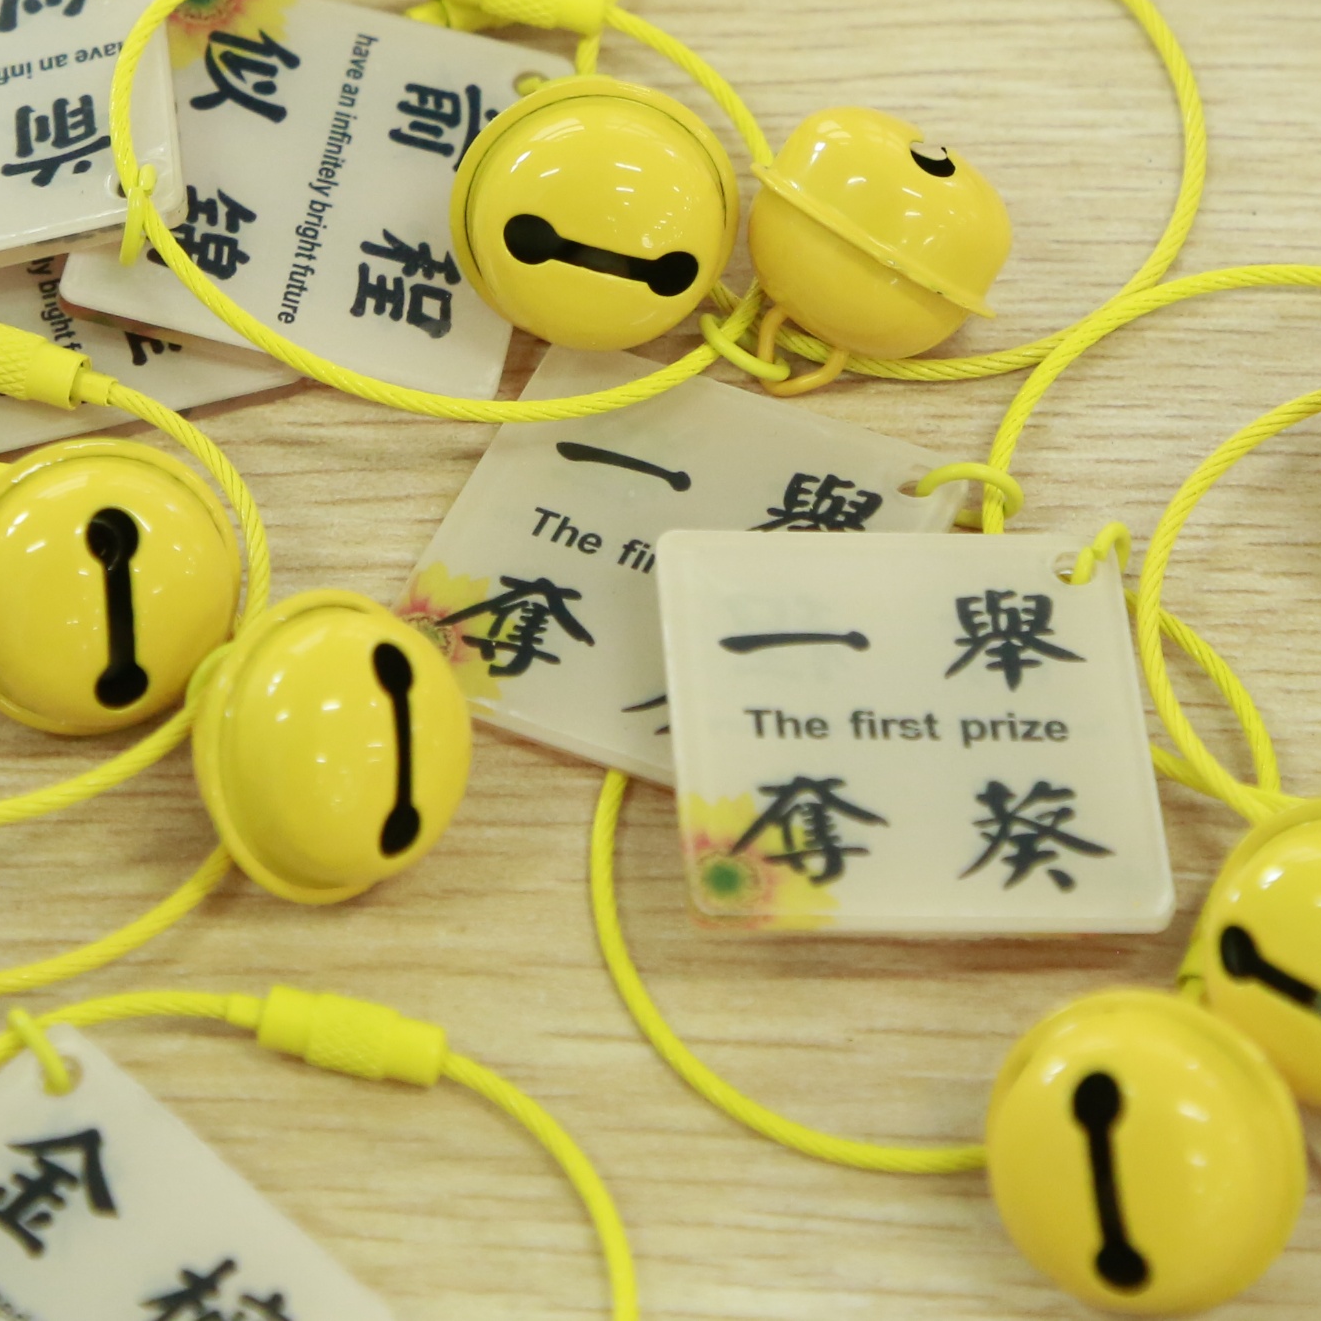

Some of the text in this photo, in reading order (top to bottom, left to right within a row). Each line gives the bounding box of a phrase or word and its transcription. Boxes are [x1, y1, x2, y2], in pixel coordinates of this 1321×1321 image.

[39, 52, 68, 72] an
[75, 40, 124, 64] ave
[277, 33, 379, 325] have an infinitely bright future
[532, 506, 604, 556] The
[743, 708, 1071, 749] The first prize
